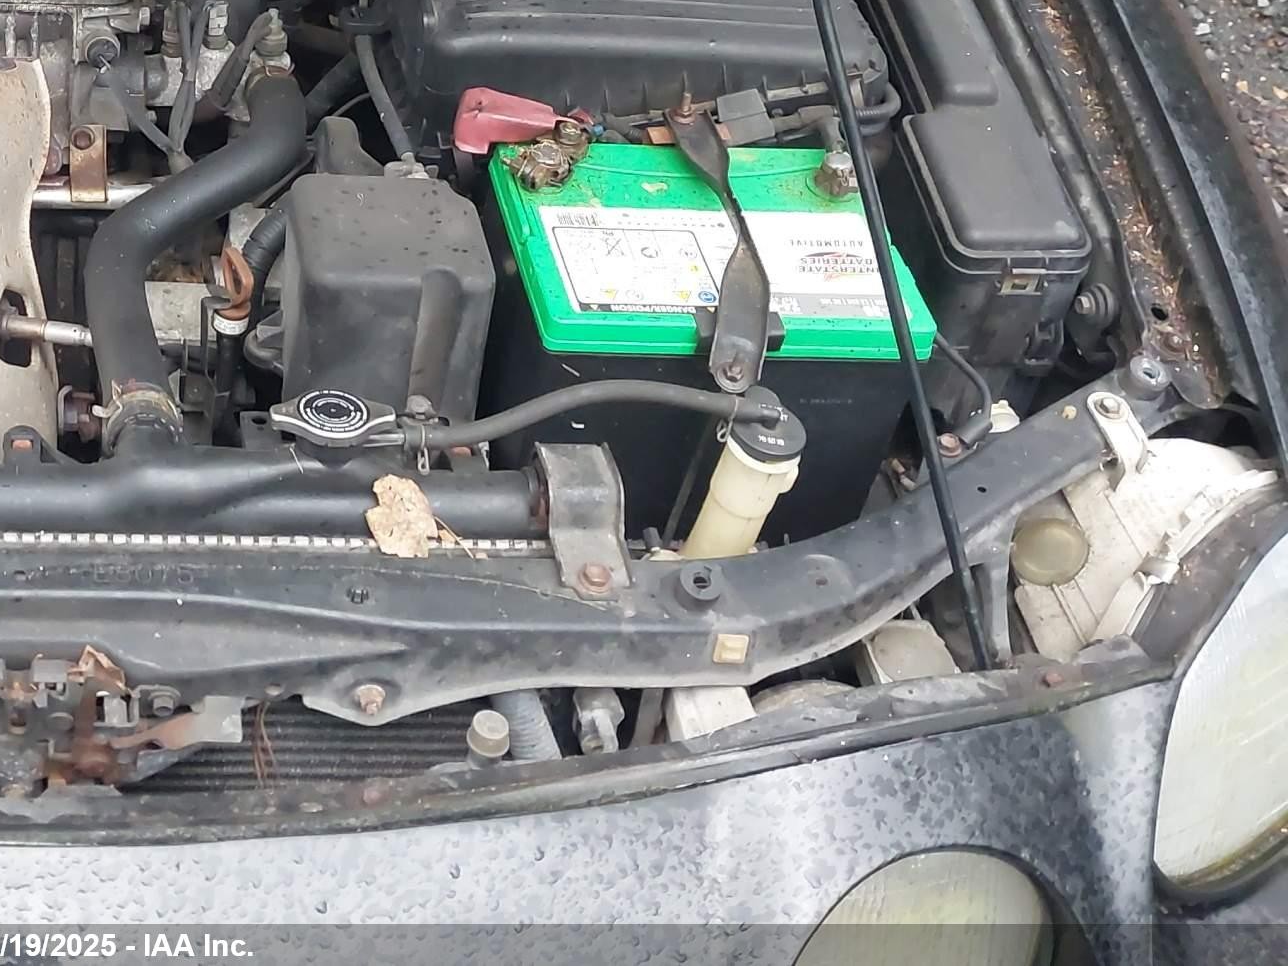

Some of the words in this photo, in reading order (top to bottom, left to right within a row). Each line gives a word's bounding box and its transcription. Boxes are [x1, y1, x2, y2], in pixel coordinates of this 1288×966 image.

[789, 239, 864, 248] AUTOMOTIVE
[800, 257, 874, 266] BATTERIES
[798, 265, 880, 275] INTERSTATE
